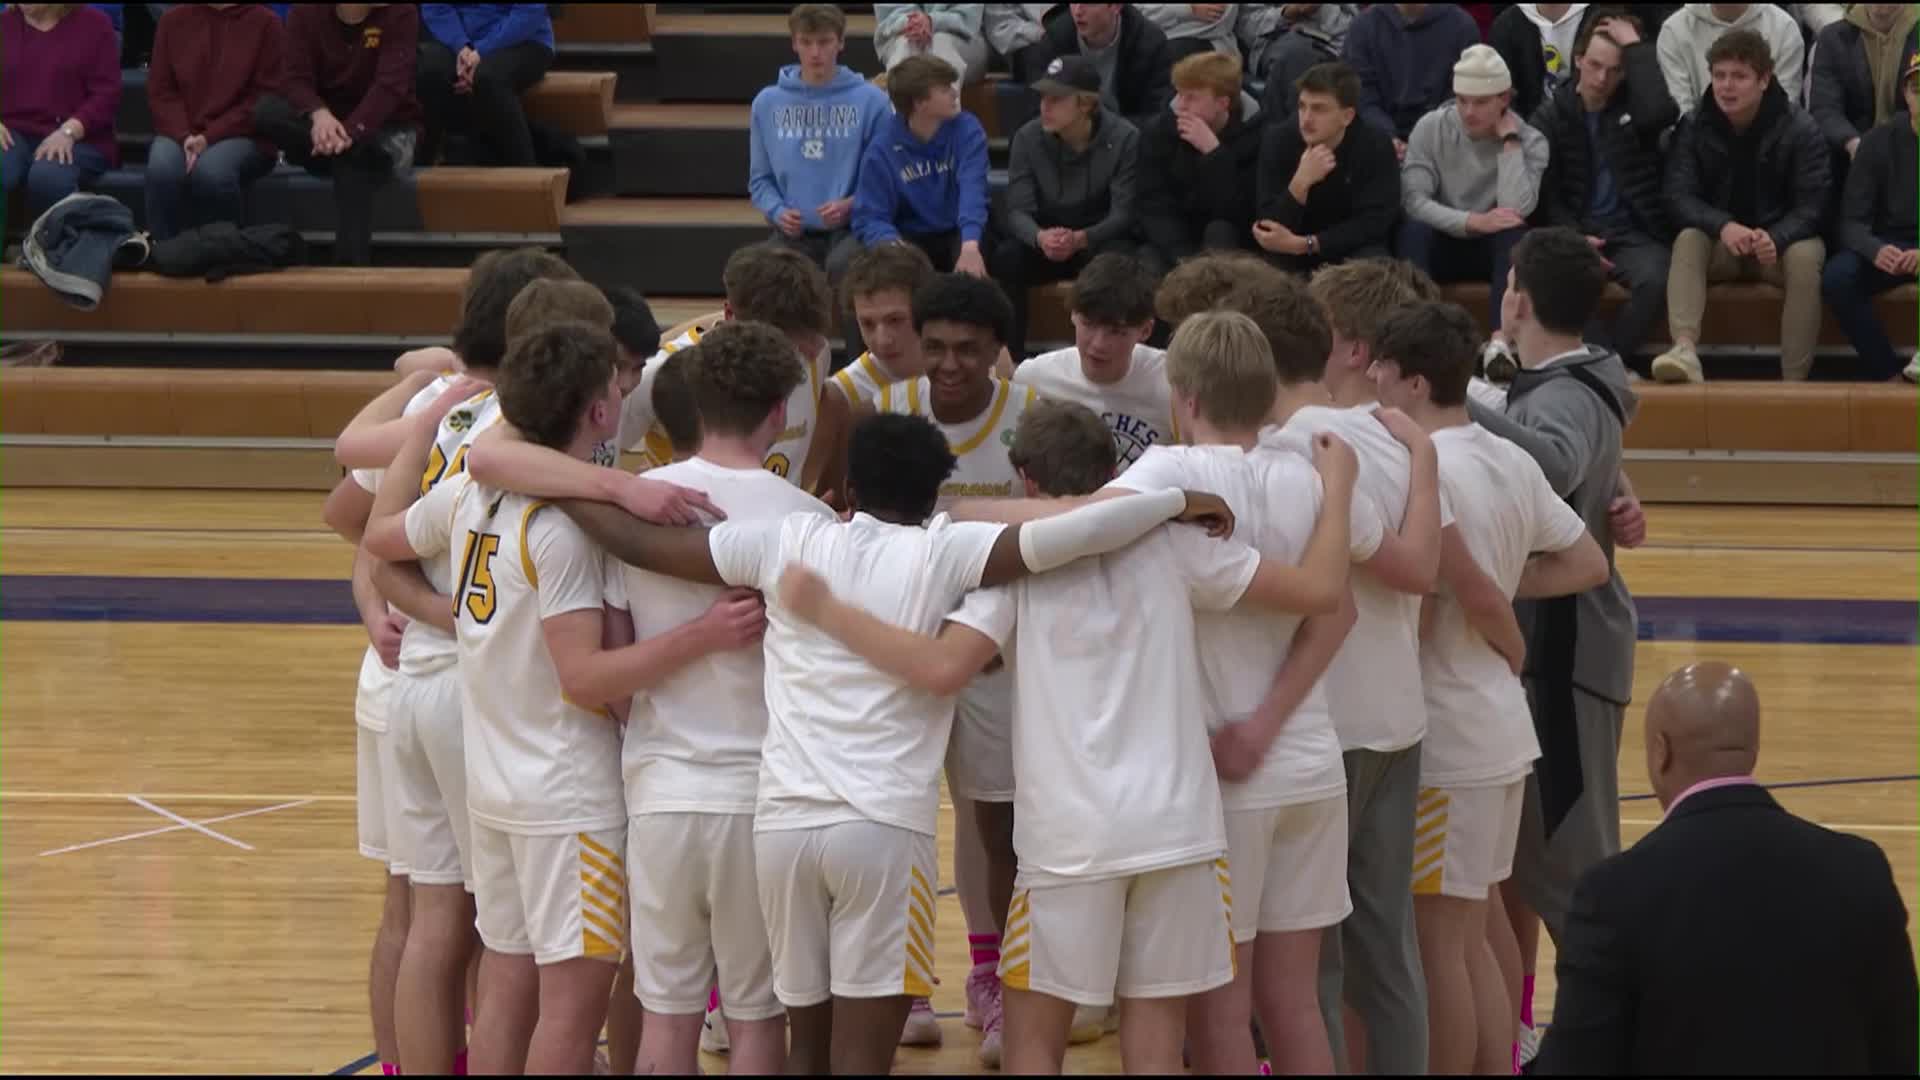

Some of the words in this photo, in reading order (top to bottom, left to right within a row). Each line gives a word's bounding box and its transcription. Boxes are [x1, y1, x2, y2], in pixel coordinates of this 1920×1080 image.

[771, 104, 859, 129] CAROLINA
[777, 127, 850, 139] BASEBALL
[452, 529, 501, 625] 15
